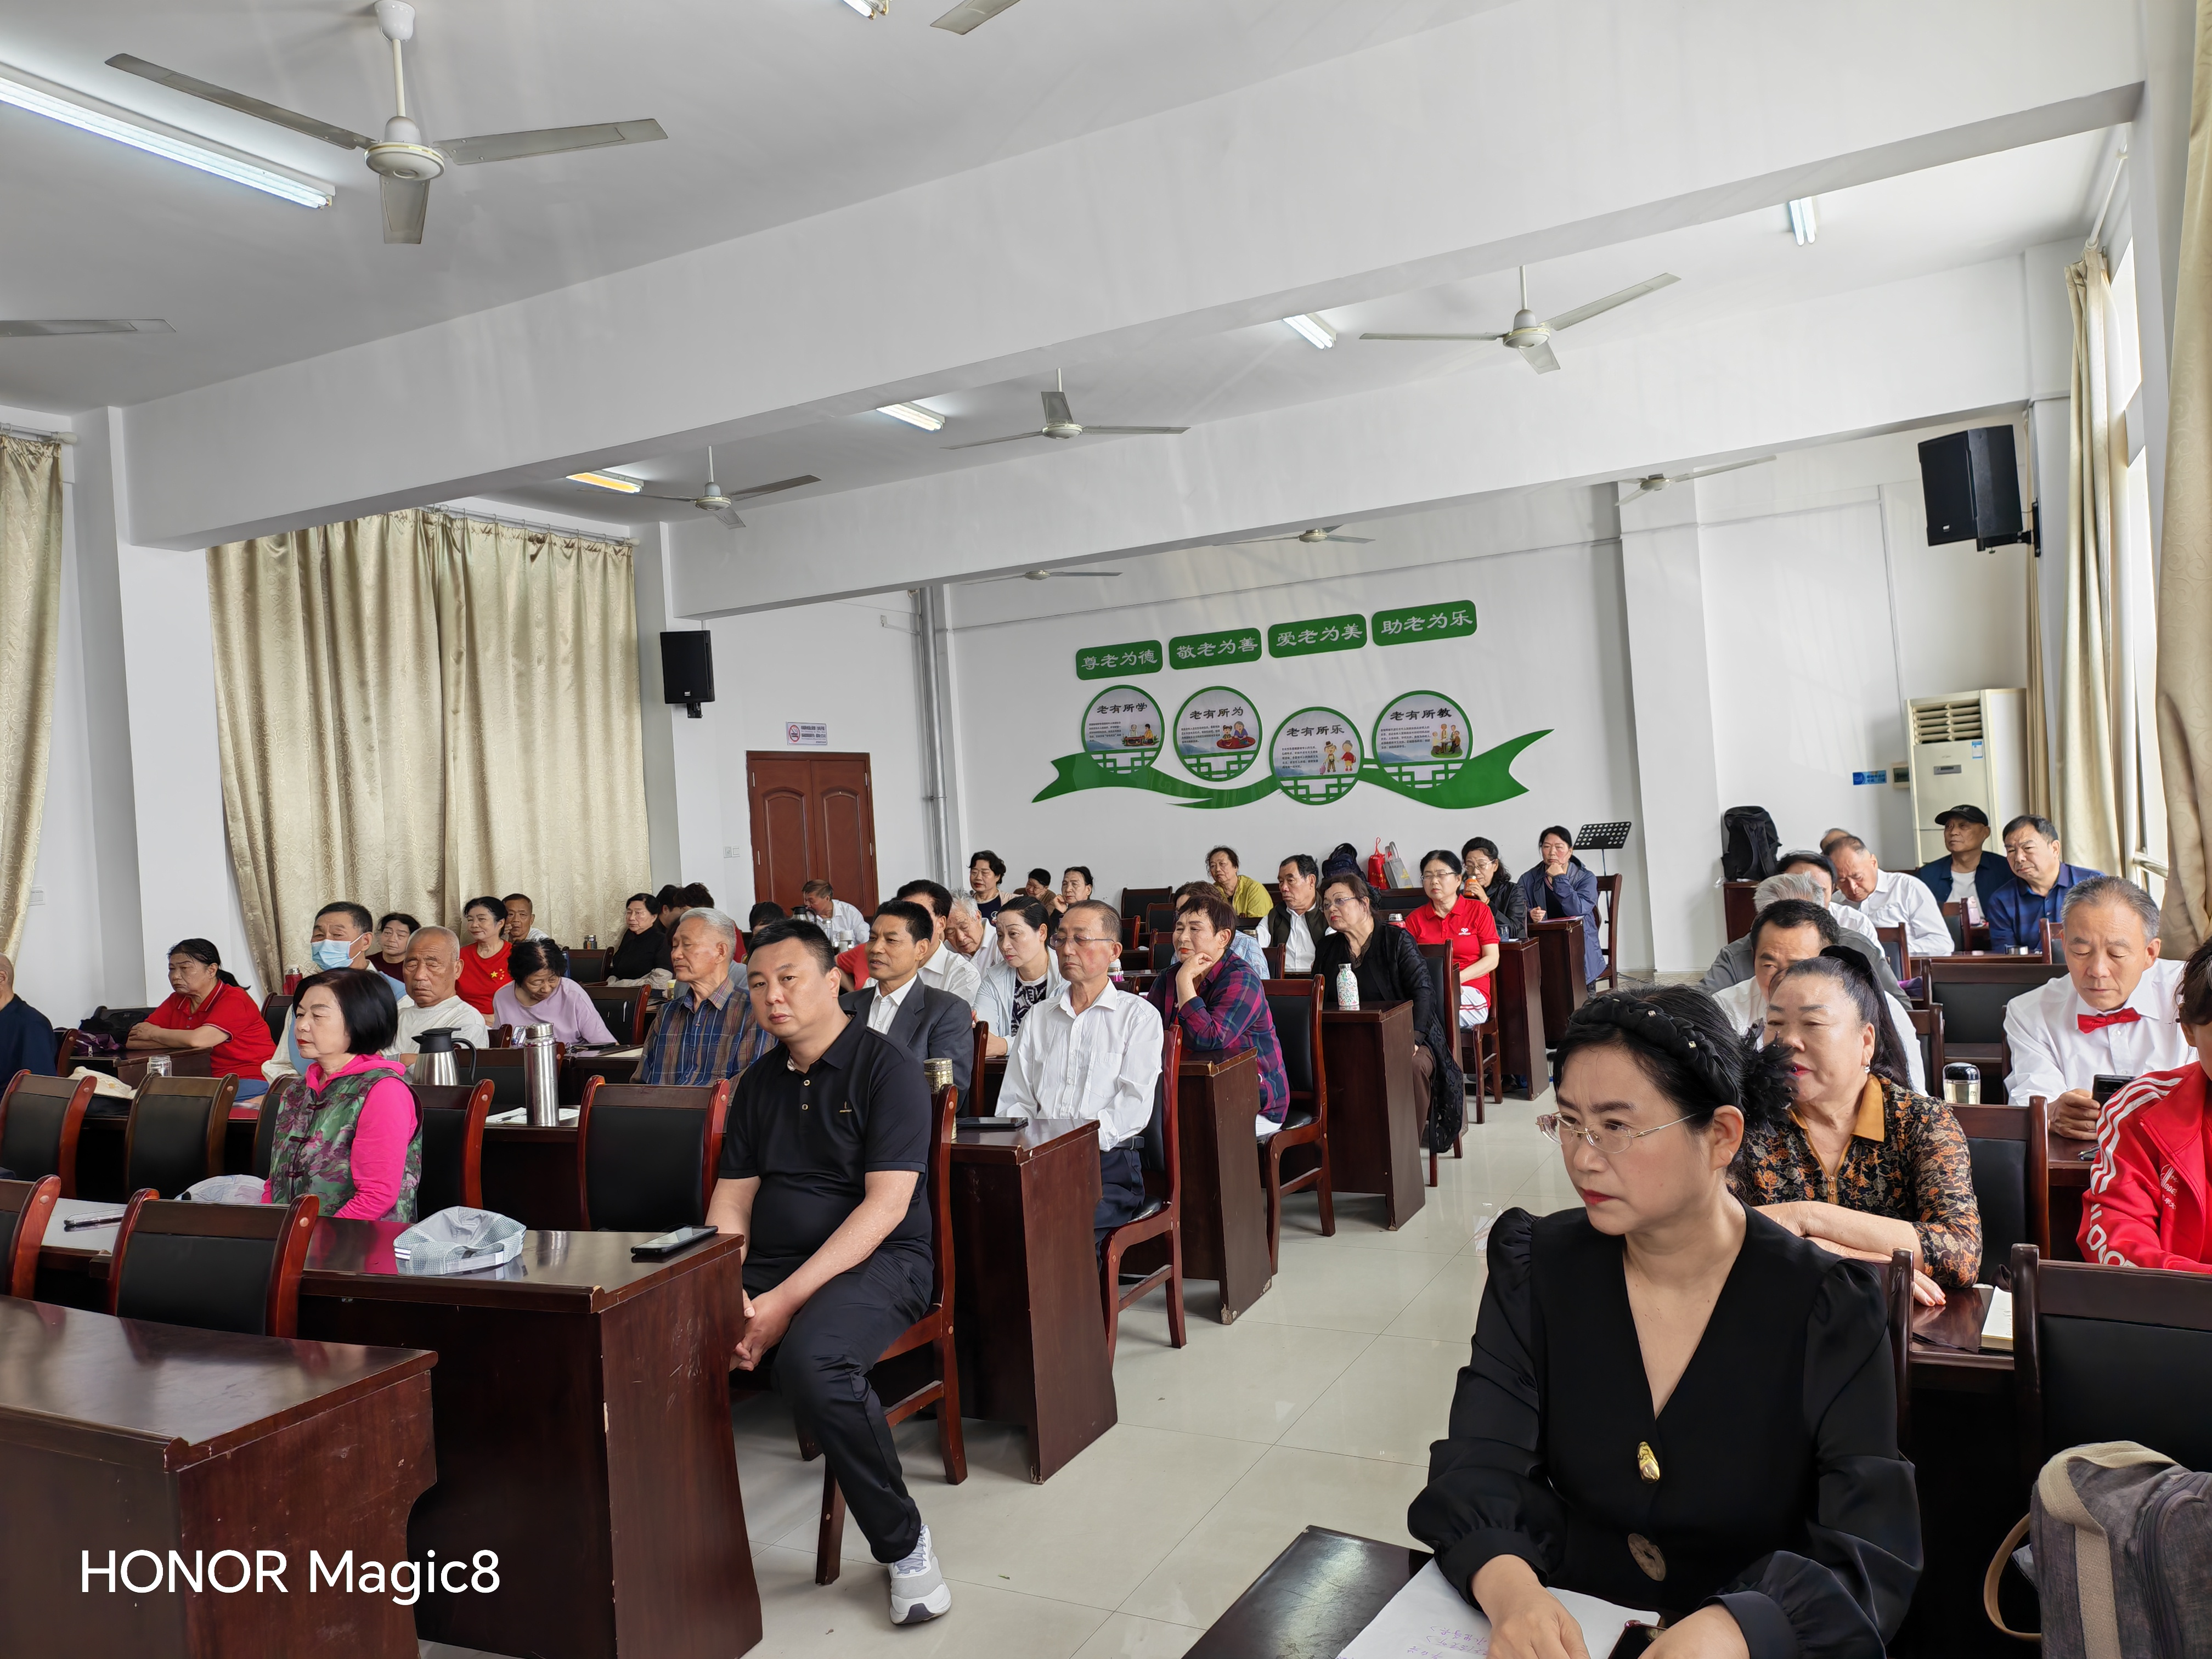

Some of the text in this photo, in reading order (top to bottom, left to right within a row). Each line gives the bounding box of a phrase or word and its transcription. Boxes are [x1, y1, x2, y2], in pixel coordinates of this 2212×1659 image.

[1381, 610, 1474, 635] 助老为乐
[1276, 623, 1363, 647] 爱老为美
[1176, 637, 1258, 659] 敬老为善
[1081, 649, 1158, 670] 尊老为德
[1097, 702, 1148, 714] 老有所学
[1189, 706, 1244, 719] 老有所为
[1390, 708, 1452, 721] 老有所教
[1286, 724, 1345, 737] 老有所乐
